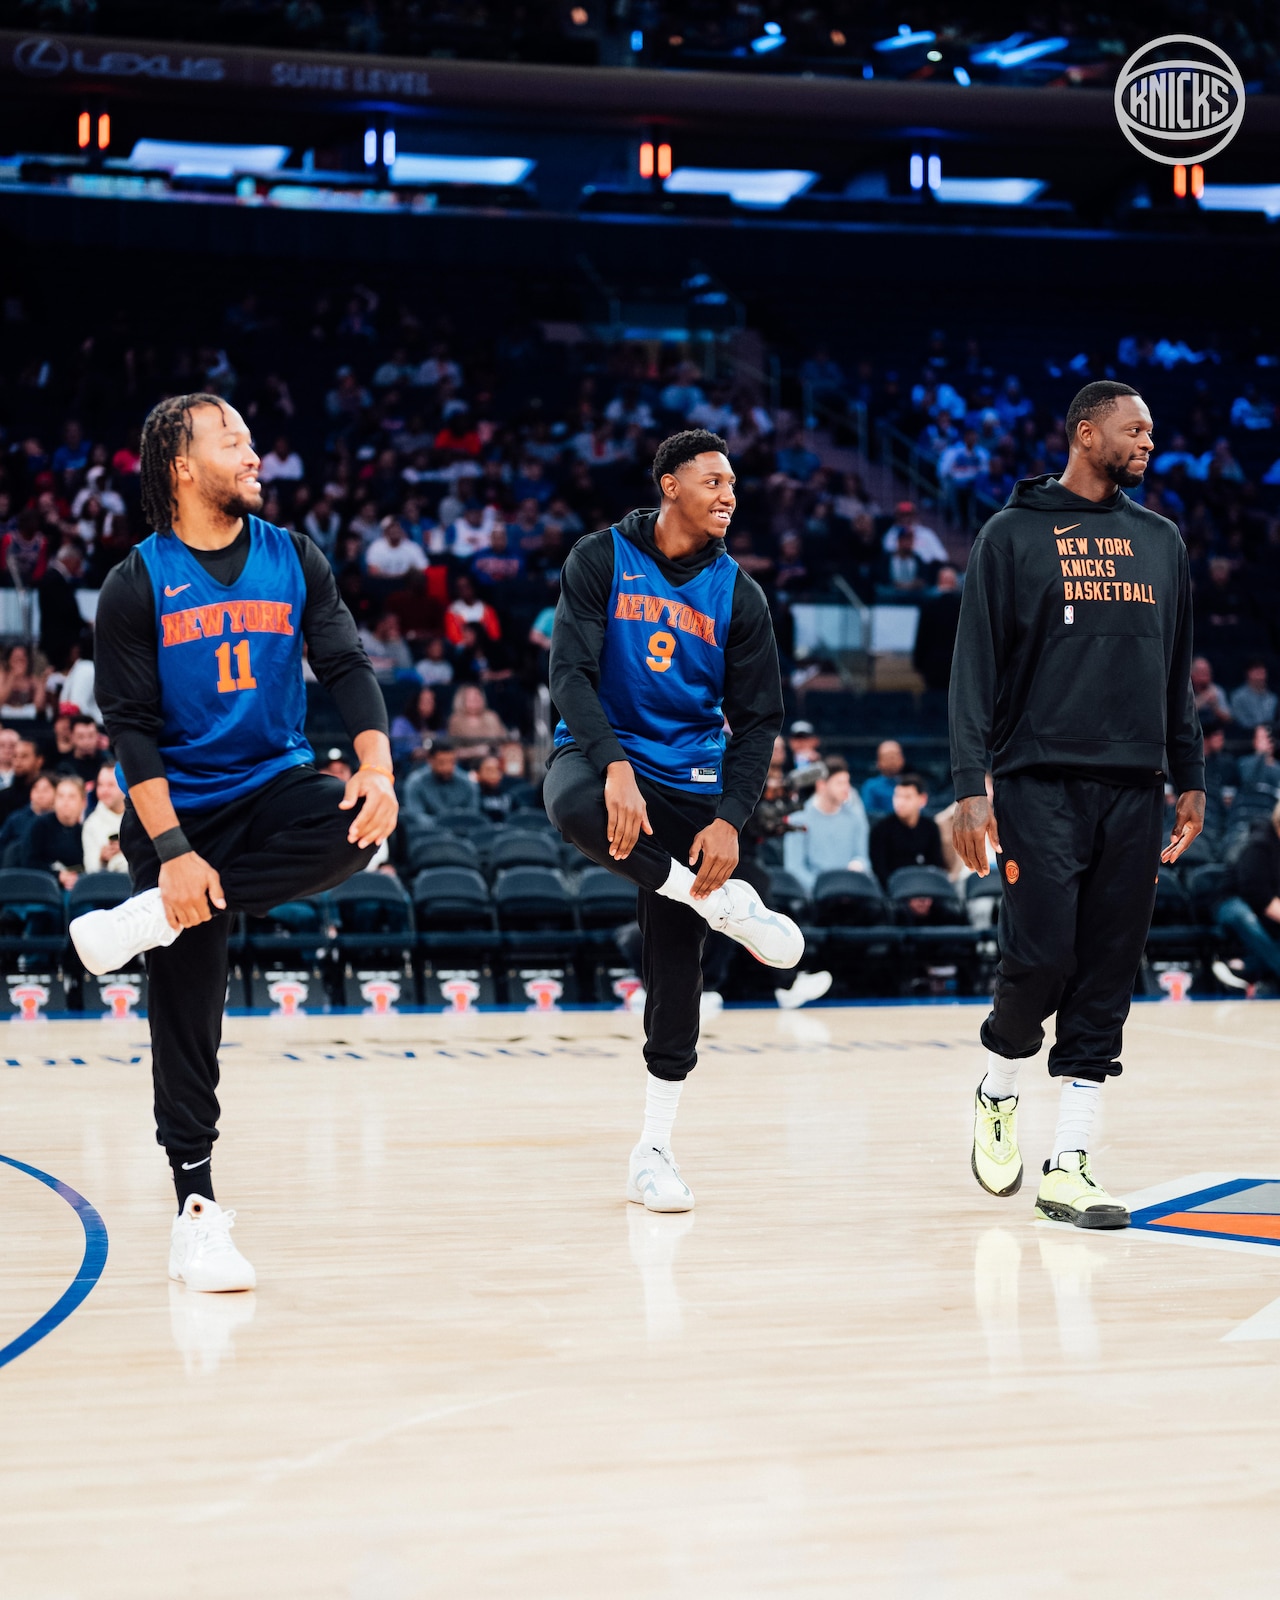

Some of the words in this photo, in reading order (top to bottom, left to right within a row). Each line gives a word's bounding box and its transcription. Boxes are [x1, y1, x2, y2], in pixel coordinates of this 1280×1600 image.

[72, 50, 225, 81] LEXUS
[1056, 538, 1088, 556] NEW
[1094, 538, 1134, 556] YORK
[1060, 559, 1116, 577] KNICKS
[1064, 581, 1156, 604] BASKETBALL
[646, 631, 676, 673] 9
[215, 639, 257, 693] 11
